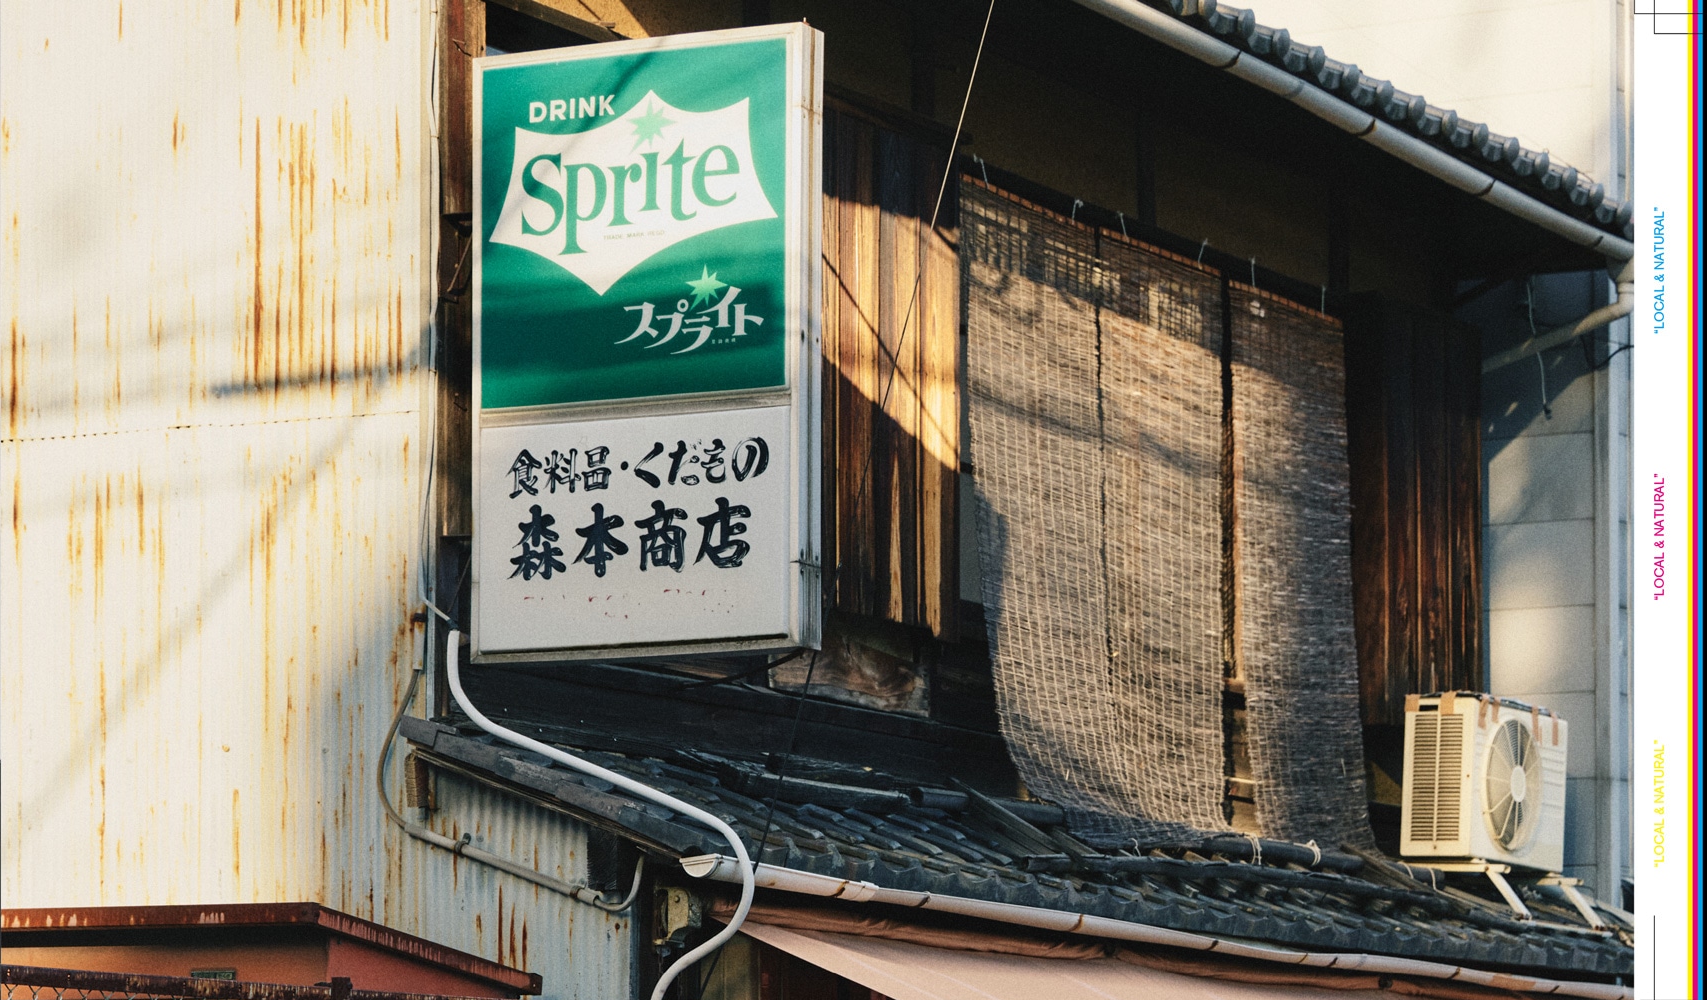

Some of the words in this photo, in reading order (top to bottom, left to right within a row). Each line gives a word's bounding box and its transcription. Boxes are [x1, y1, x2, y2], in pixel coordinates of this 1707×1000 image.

[529, 94, 616, 123] DRINK
[521, 138, 740, 256] Sprite
[614, 286, 765, 355] スプライト
[507, 496, 751, 581] 森本商店
